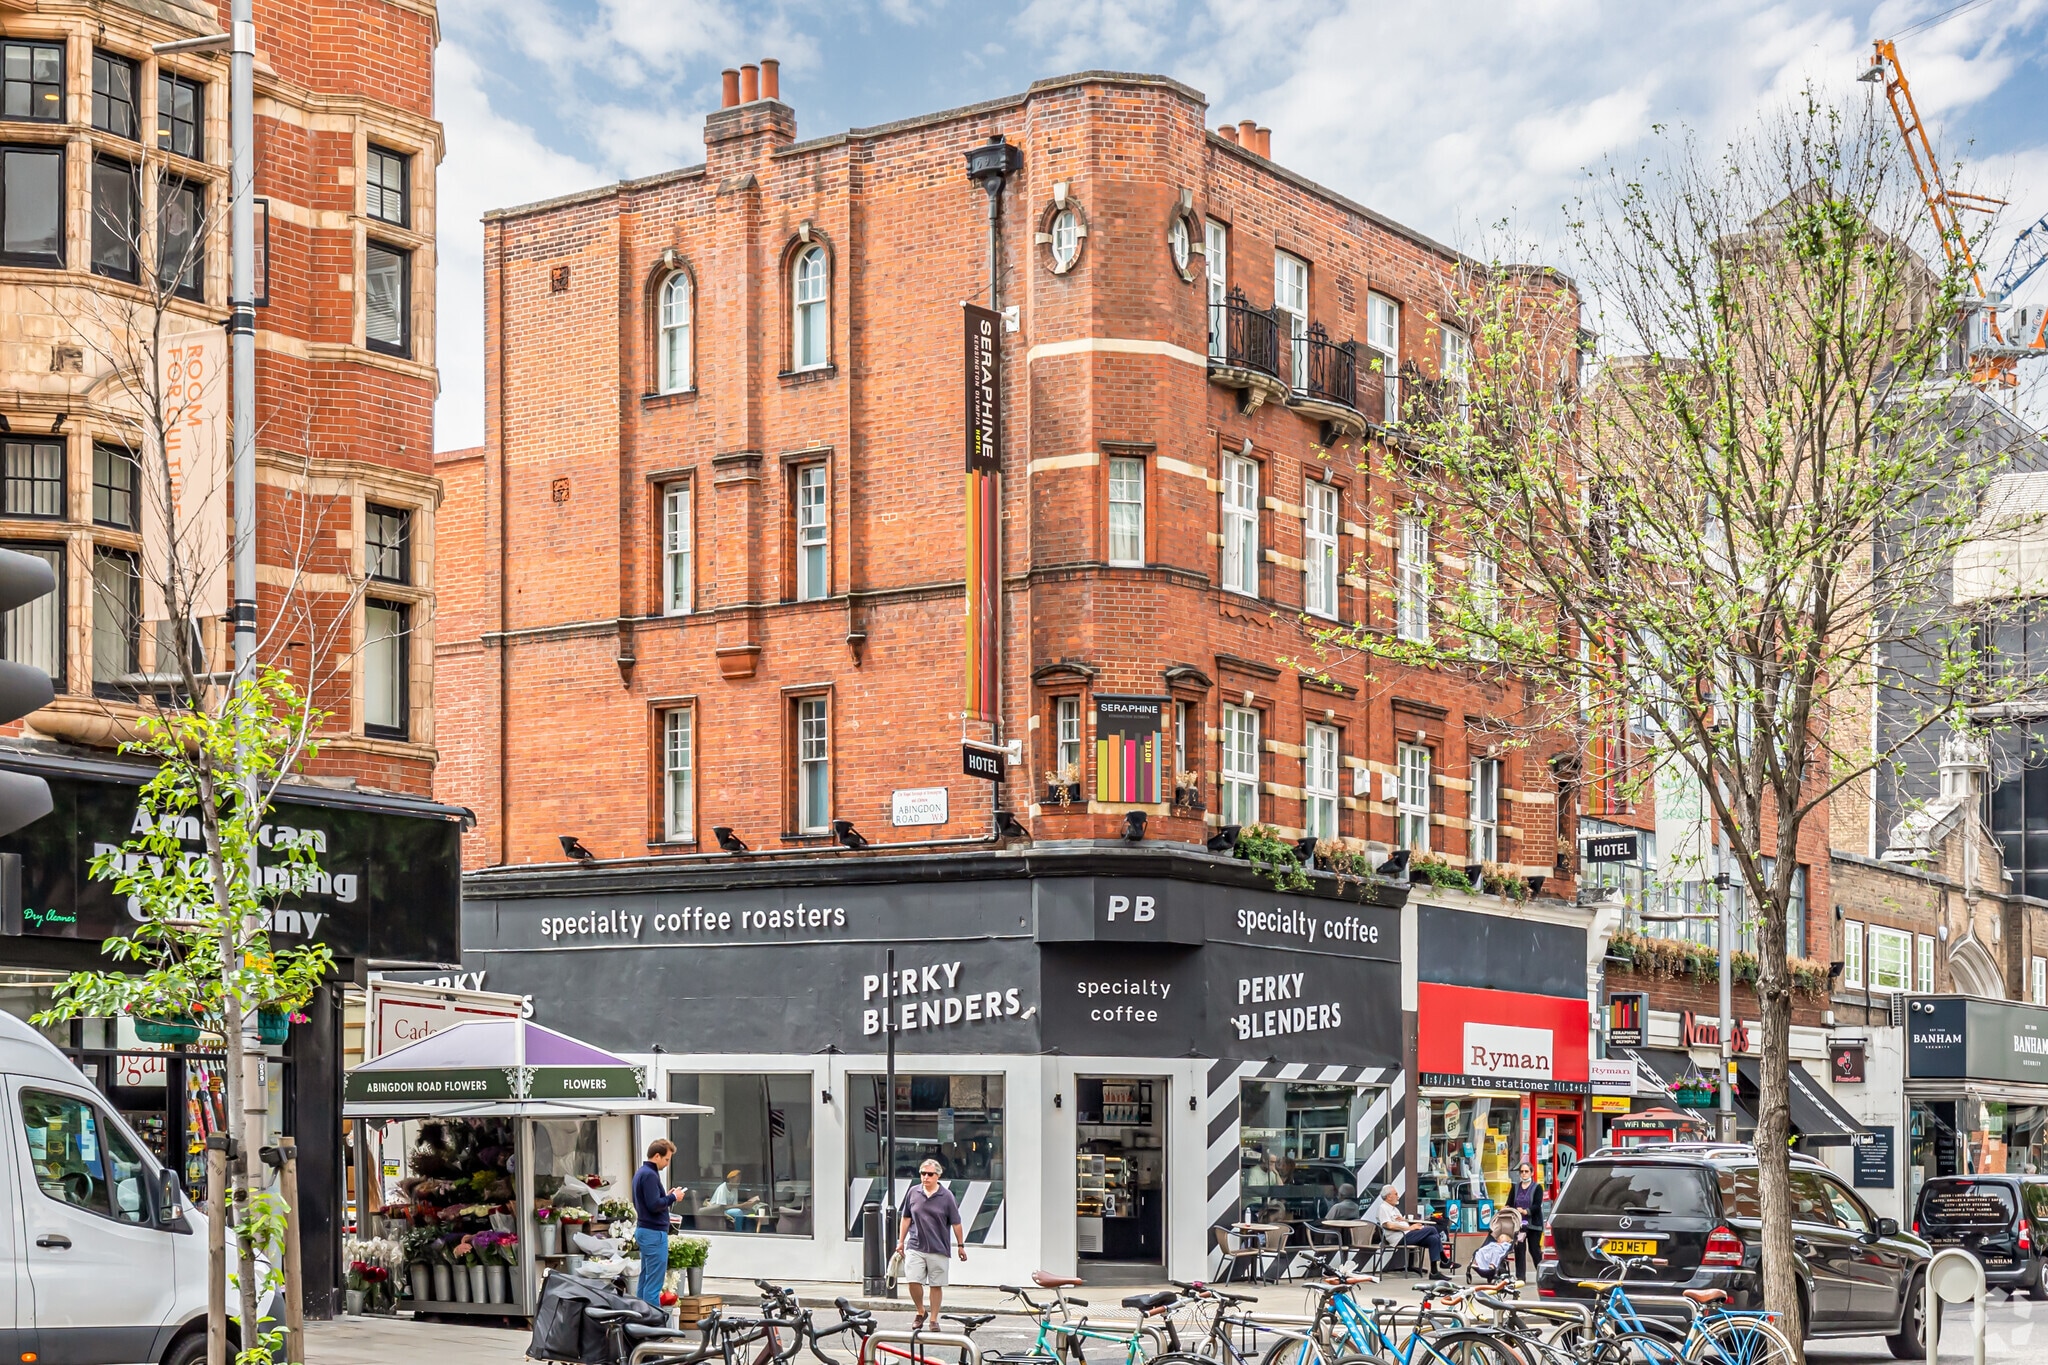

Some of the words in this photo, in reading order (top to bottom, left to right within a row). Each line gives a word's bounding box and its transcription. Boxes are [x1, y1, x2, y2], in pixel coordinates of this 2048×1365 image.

[167, 347, 183, 398] FOR
[187, 344, 203, 427] ROOM
[981, 319, 993, 458] SERAPHINE
[1100, 703, 1158, 714] SERAPHINE
[969, 754, 999, 774] HOTEL
[899, 803, 941, 814] ABINGDON
[896, 814, 920, 823] ROAD
[1594, 843, 1630, 857] HOTEL
[24, 908, 44, 928] Dry
[541, 910, 643, 940] specialty
[654, 906, 732, 932] coffee
[742, 903, 846, 929] roasters
[1237, 908, 1317, 943] specialty
[1324, 916, 1379, 944] coffee
[1077, 979, 1171, 999] specialty
[1238, 972, 1304, 1004] PERKY
[1090, 1006, 1158, 1022] coffee
[1238, 1002, 1342, 1040] BLENDERS
[1682, 1010, 1749, 1052] Nano's
[1914, 1034, 1962, 1044] BANHAM
[2014, 1035, 2048, 1054] BANHAM
[1471, 1046, 1550, 1072] Ryman
[1592, 1067, 1630, 1075] Ryman
[366, 1080, 414, 1092] ABINGDON
[417, 1080, 442, 1092] ROAD
[444, 1080, 487, 1092] FLOWERS
[564, 1078, 607, 1090] FLOWERS
[1471, 1076, 1490, 1087] the
[1495, 1079, 1550, 1091] stationer
[1611, 1241, 1624, 1252] D3
[1627, 1242, 1648, 1252] MET
